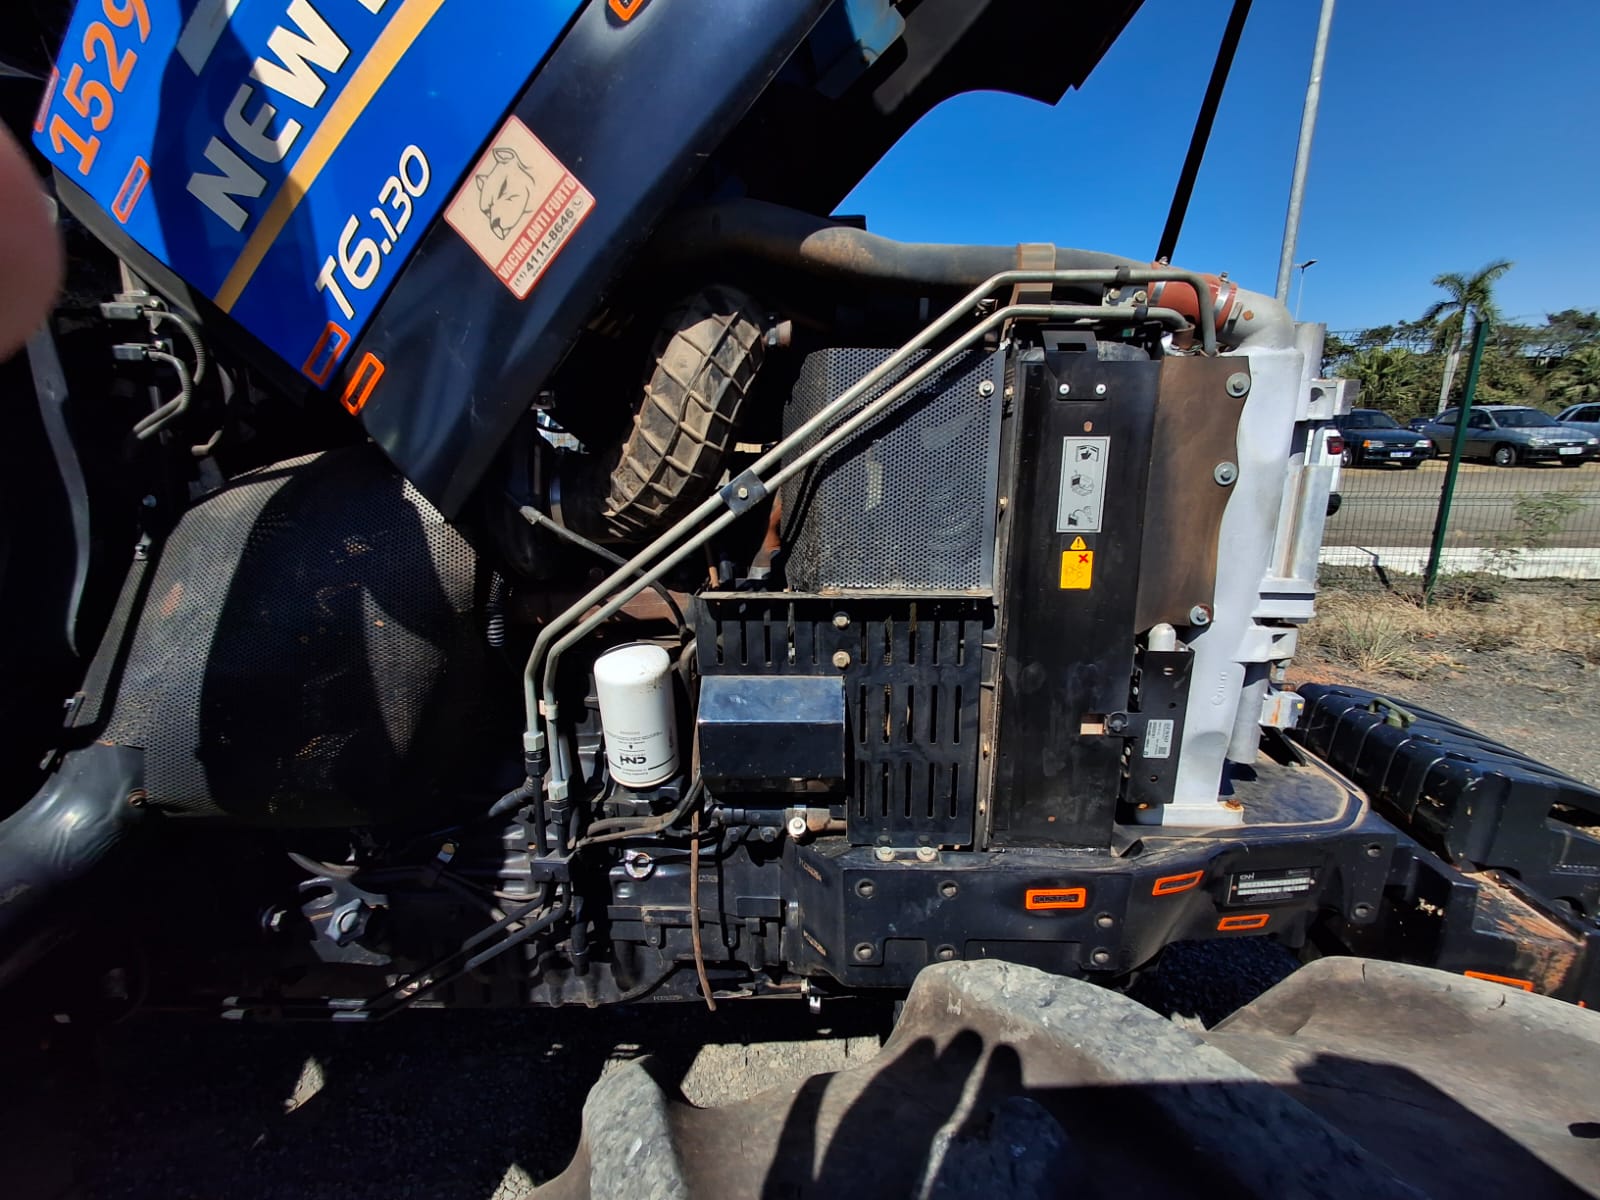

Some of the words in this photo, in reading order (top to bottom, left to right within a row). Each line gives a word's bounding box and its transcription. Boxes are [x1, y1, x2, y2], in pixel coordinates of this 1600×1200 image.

[49, 0, 151, 176] 1529
[185, 0, 351, 232] NEW
[315, 144, 431, 320] T6.130
[497, 236, 534, 280] VACINA
[525, 208, 552, 242] ANTI
[545, 175, 578, 216] FURTO
[514, 271, 528, 288] (11)
[526, 208, 575, 272] 4111-8646
[619, 755, 647, 765] CNH
